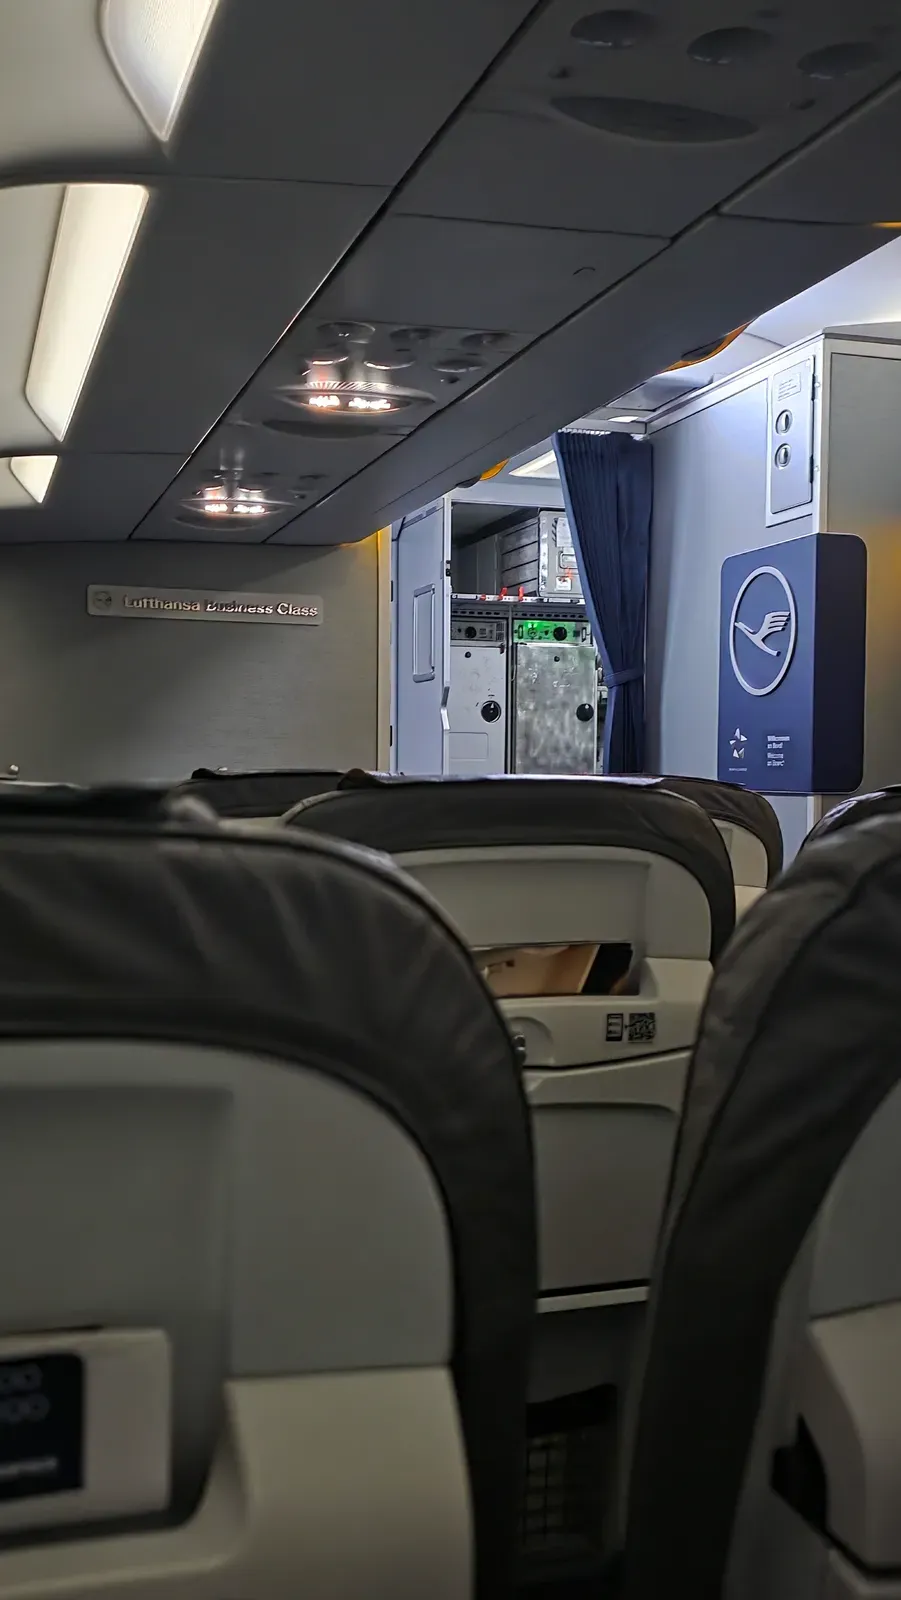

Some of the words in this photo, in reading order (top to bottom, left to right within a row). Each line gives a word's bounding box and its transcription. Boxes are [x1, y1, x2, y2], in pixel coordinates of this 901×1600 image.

[123, 594, 201, 611] Lufthansa
[204, 598, 274, 615] Business
[276, 602, 318, 617] Class
